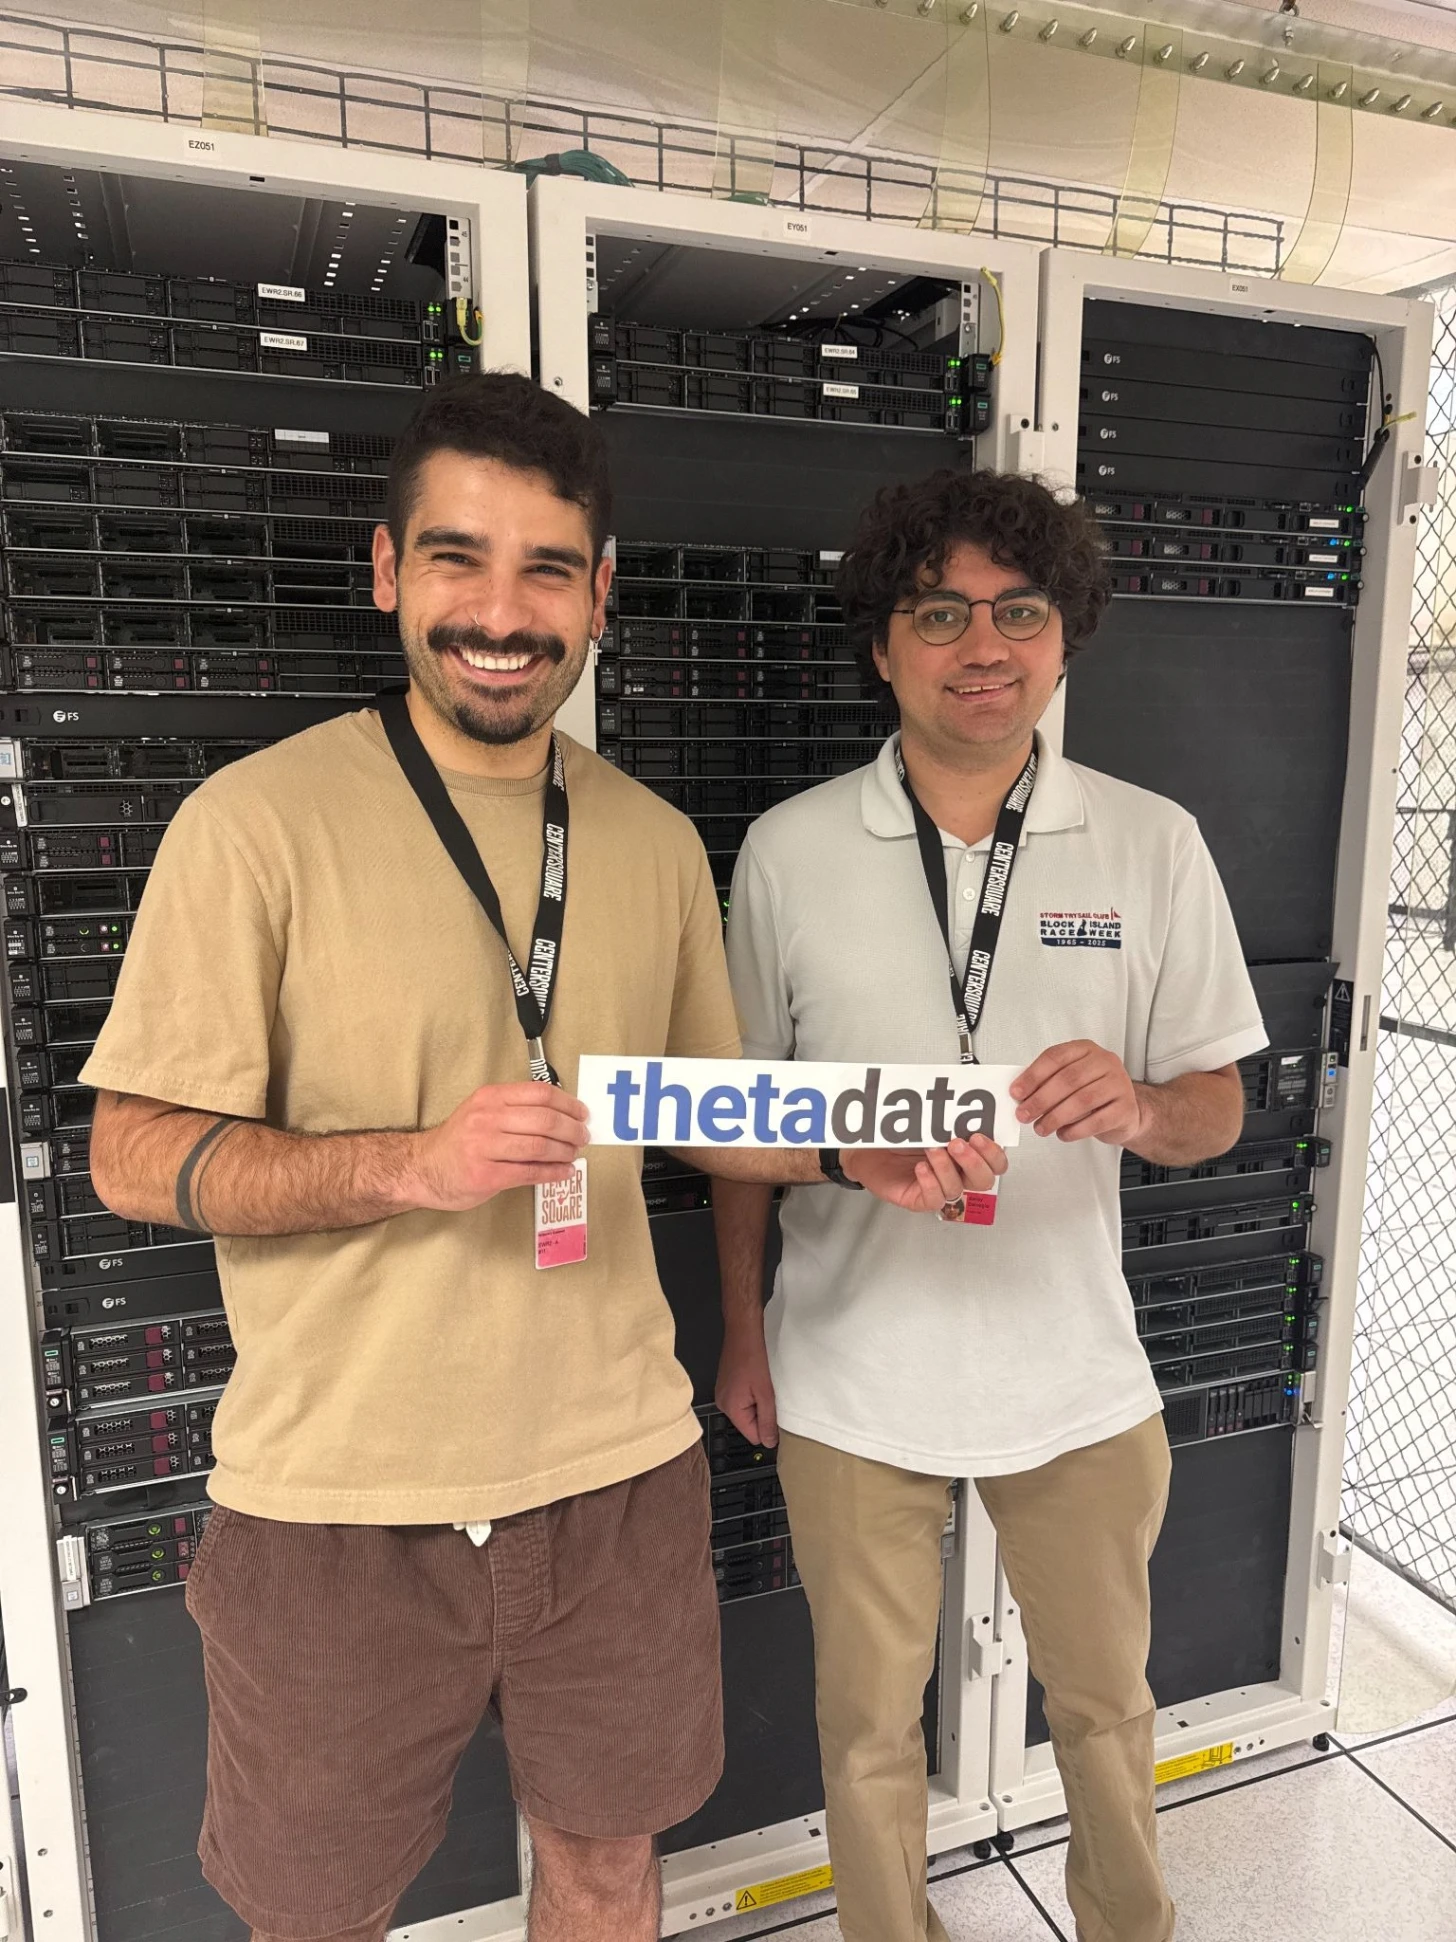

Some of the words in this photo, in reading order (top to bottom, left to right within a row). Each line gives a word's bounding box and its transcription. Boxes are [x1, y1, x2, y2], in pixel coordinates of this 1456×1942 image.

[188, 139, 215, 151] EZ051
[787, 222, 807, 232] EY051
[543, 823, 565, 902] CENTERSQUARE
[981, 841, 1015, 917] CENTERSQUARE
[1040, 920, 1075, 928] BLOCK
[1089, 921, 1121, 929] ISLAND
[1089, 930, 1121, 938] WEEK
[529, 938, 556, 1019] CENTERSQU
[964, 950, 991, 1026] CENTERSQUAR
[607, 1061, 997, 1144] thetadata
[542, 1195, 583, 1225] SQUARE
